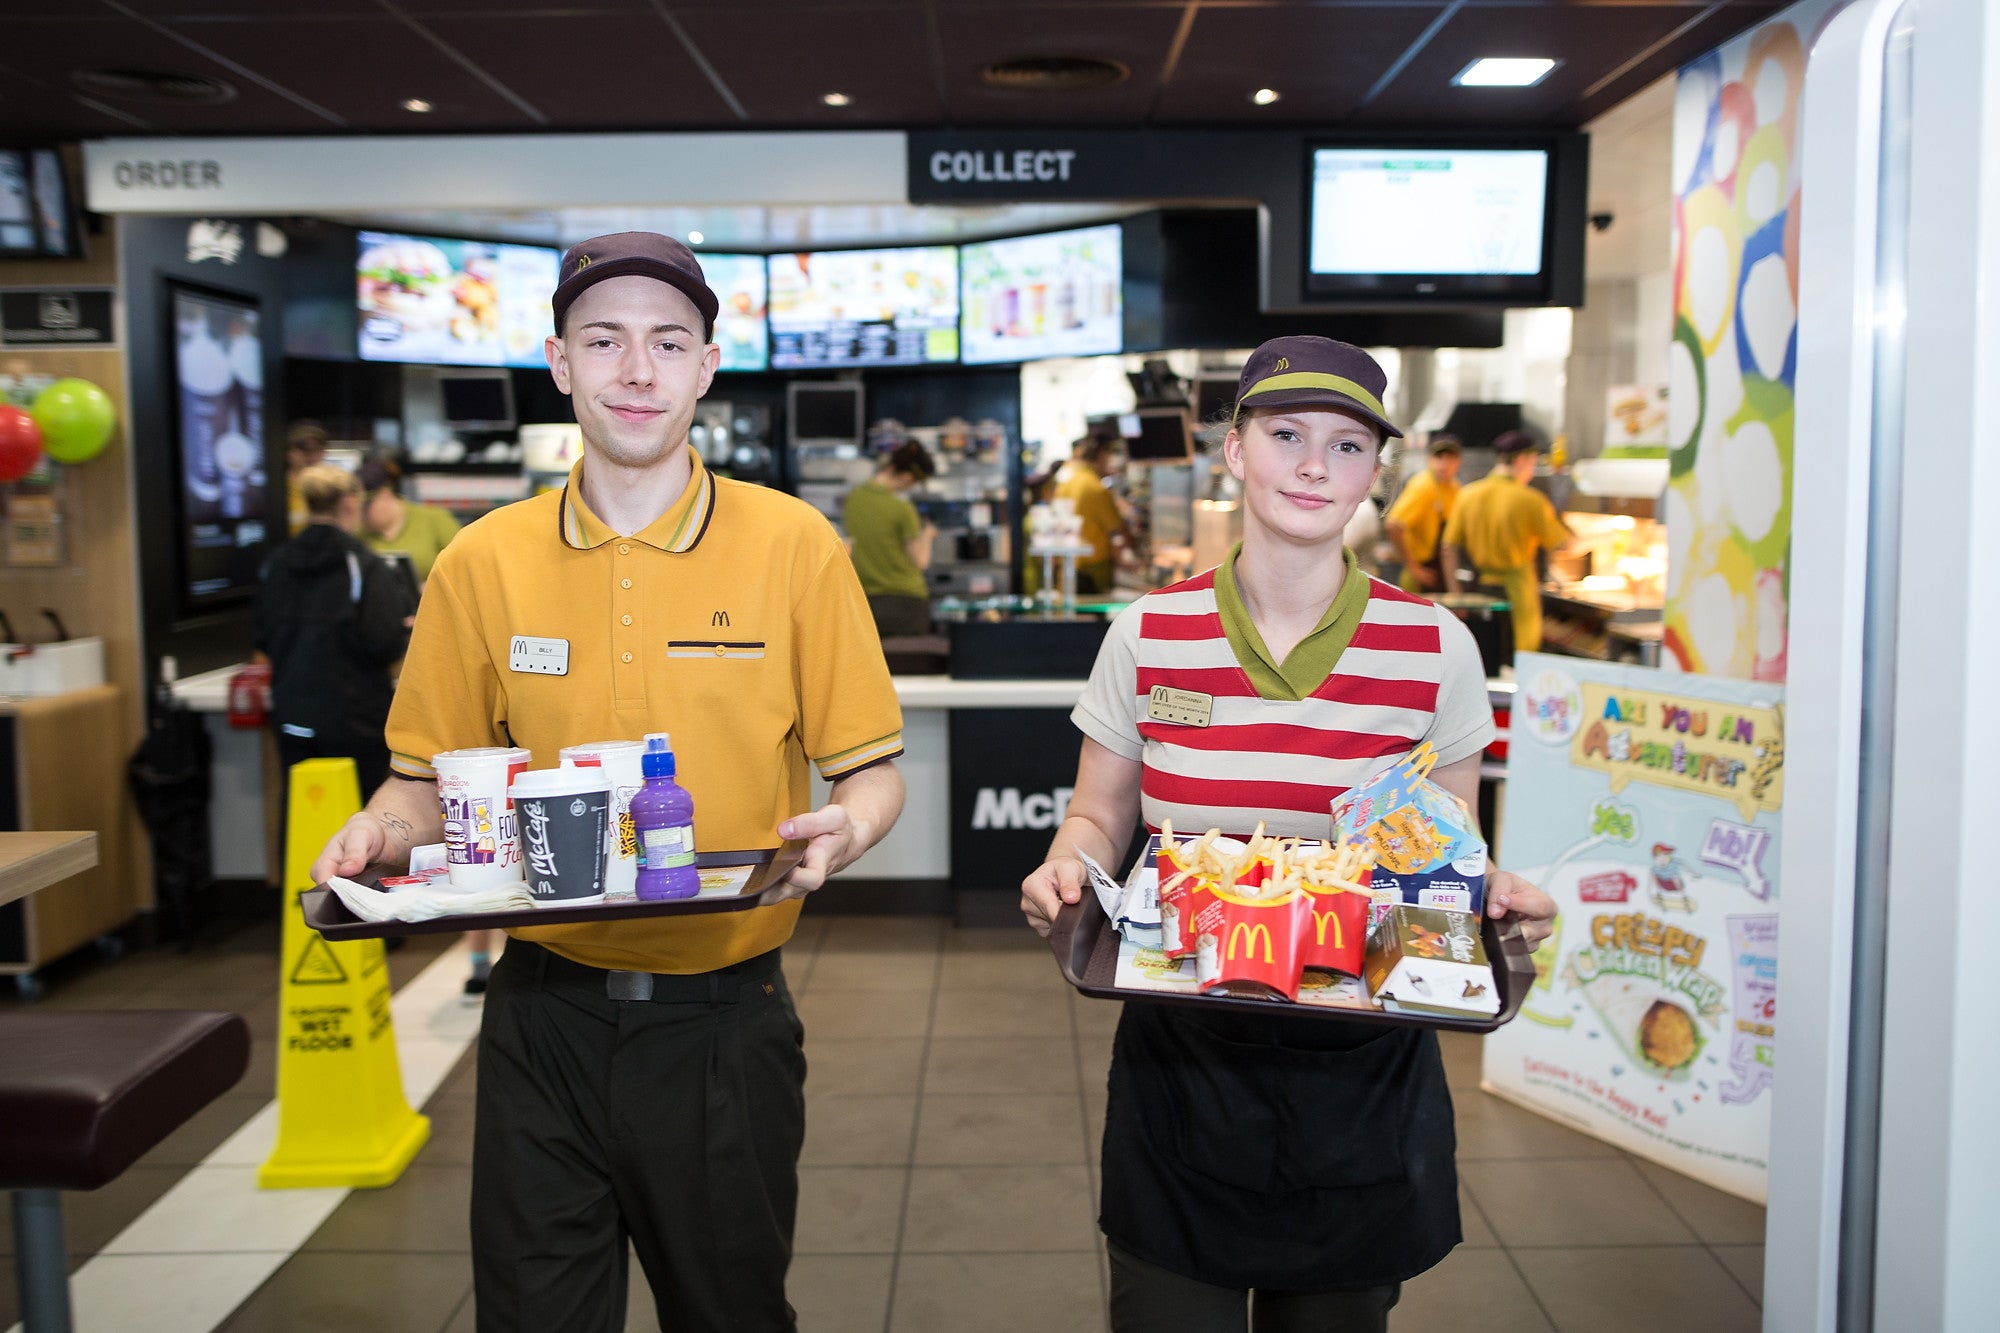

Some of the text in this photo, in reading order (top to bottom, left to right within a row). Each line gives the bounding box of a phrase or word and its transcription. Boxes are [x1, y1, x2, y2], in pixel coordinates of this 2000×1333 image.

[114, 158, 223, 191] ORDER
[930, 149, 1076, 183] COLLECT
[1603, 696, 1755, 745] ARE YOU AN
[498, 813, 518, 841] FOO
[500, 840, 523, 868] Fu
[1432, 895, 1457, 903] FREE
[301, 1017, 341, 1032] WET
[288, 1035, 353, 1051] FLOOR
